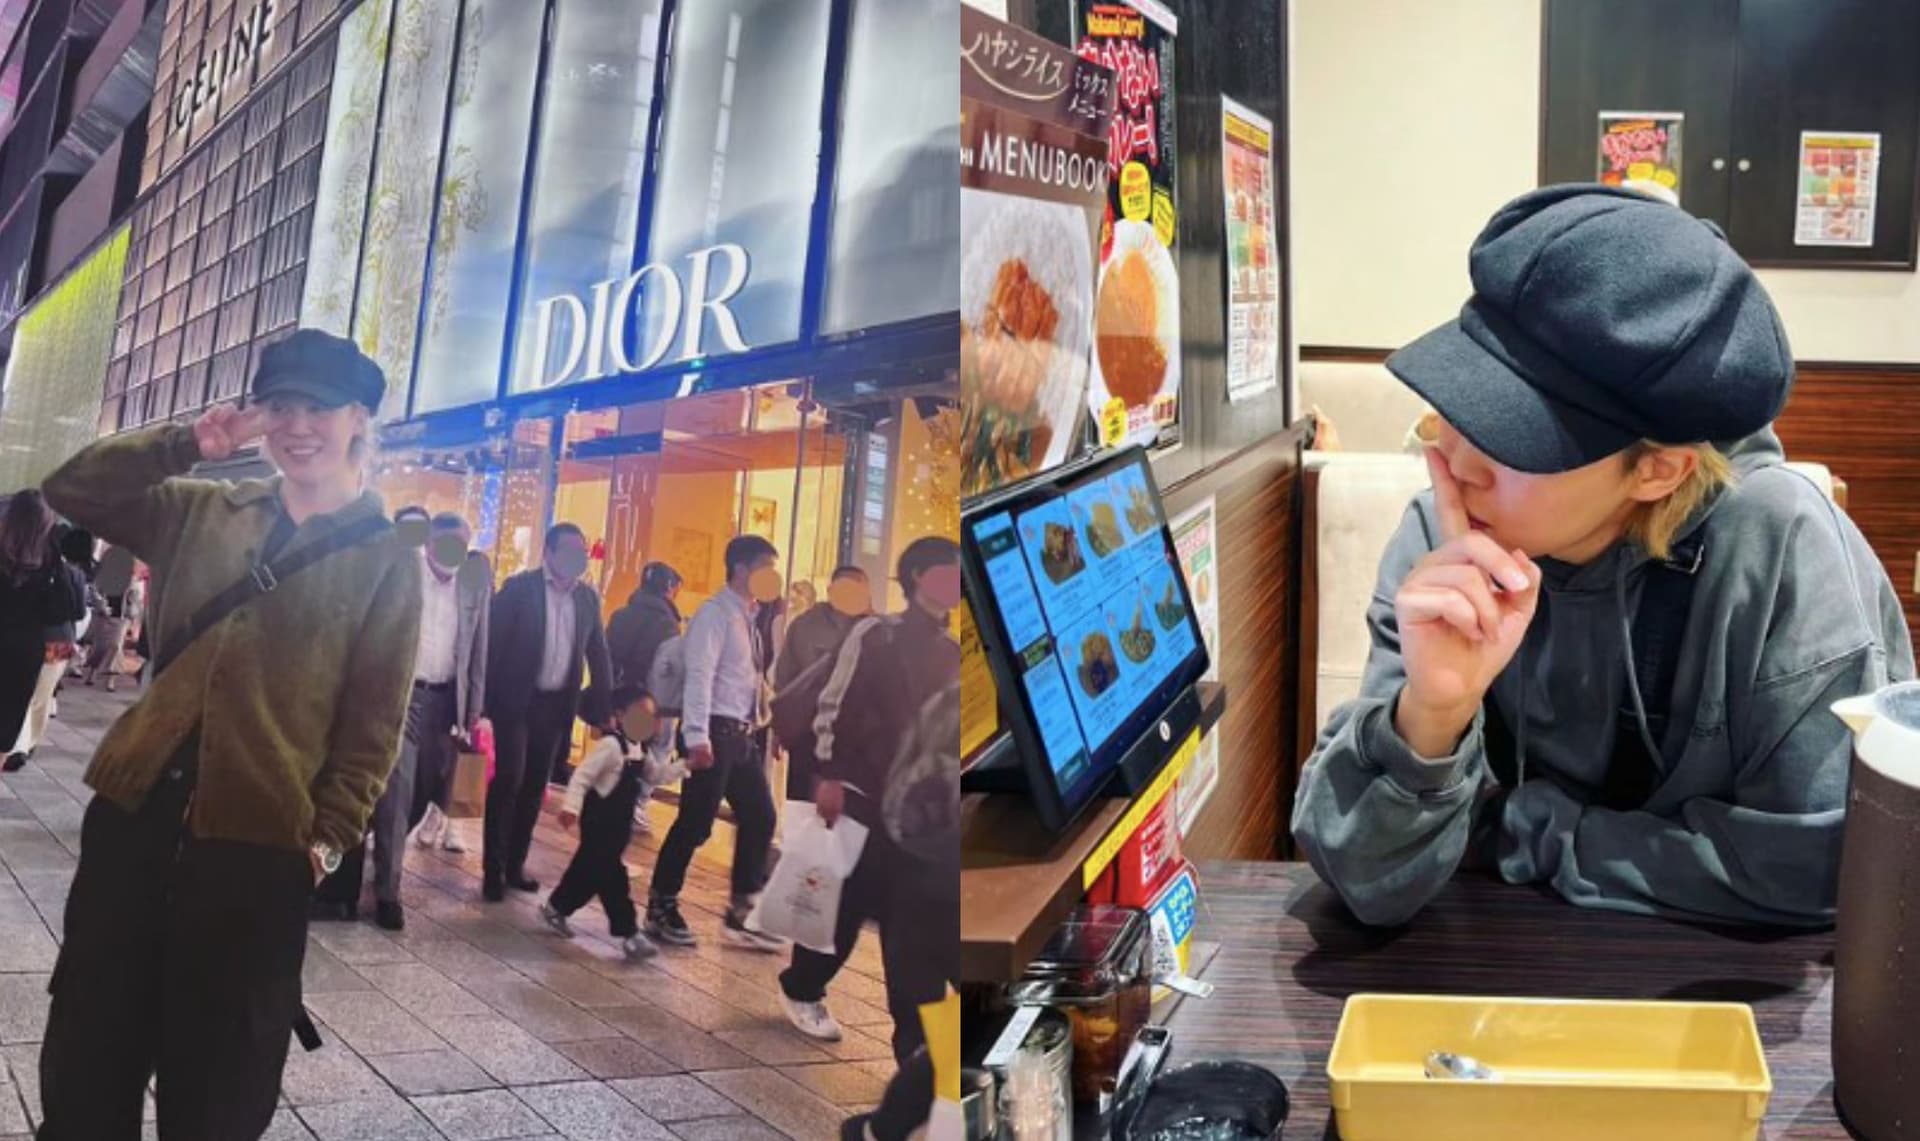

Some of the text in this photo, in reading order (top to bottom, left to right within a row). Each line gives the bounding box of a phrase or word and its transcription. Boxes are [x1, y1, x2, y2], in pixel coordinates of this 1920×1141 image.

[176, 1, 273, 128] CELINE
[968, 31, 1064, 89] ハヤシライス
[1075, 66, 1109, 97] ミックス
[1068, 94, 1107, 119] メニュー
[979, 130, 1110, 193] MENUBOOK
[528, 243, 750, 392] DIOR
